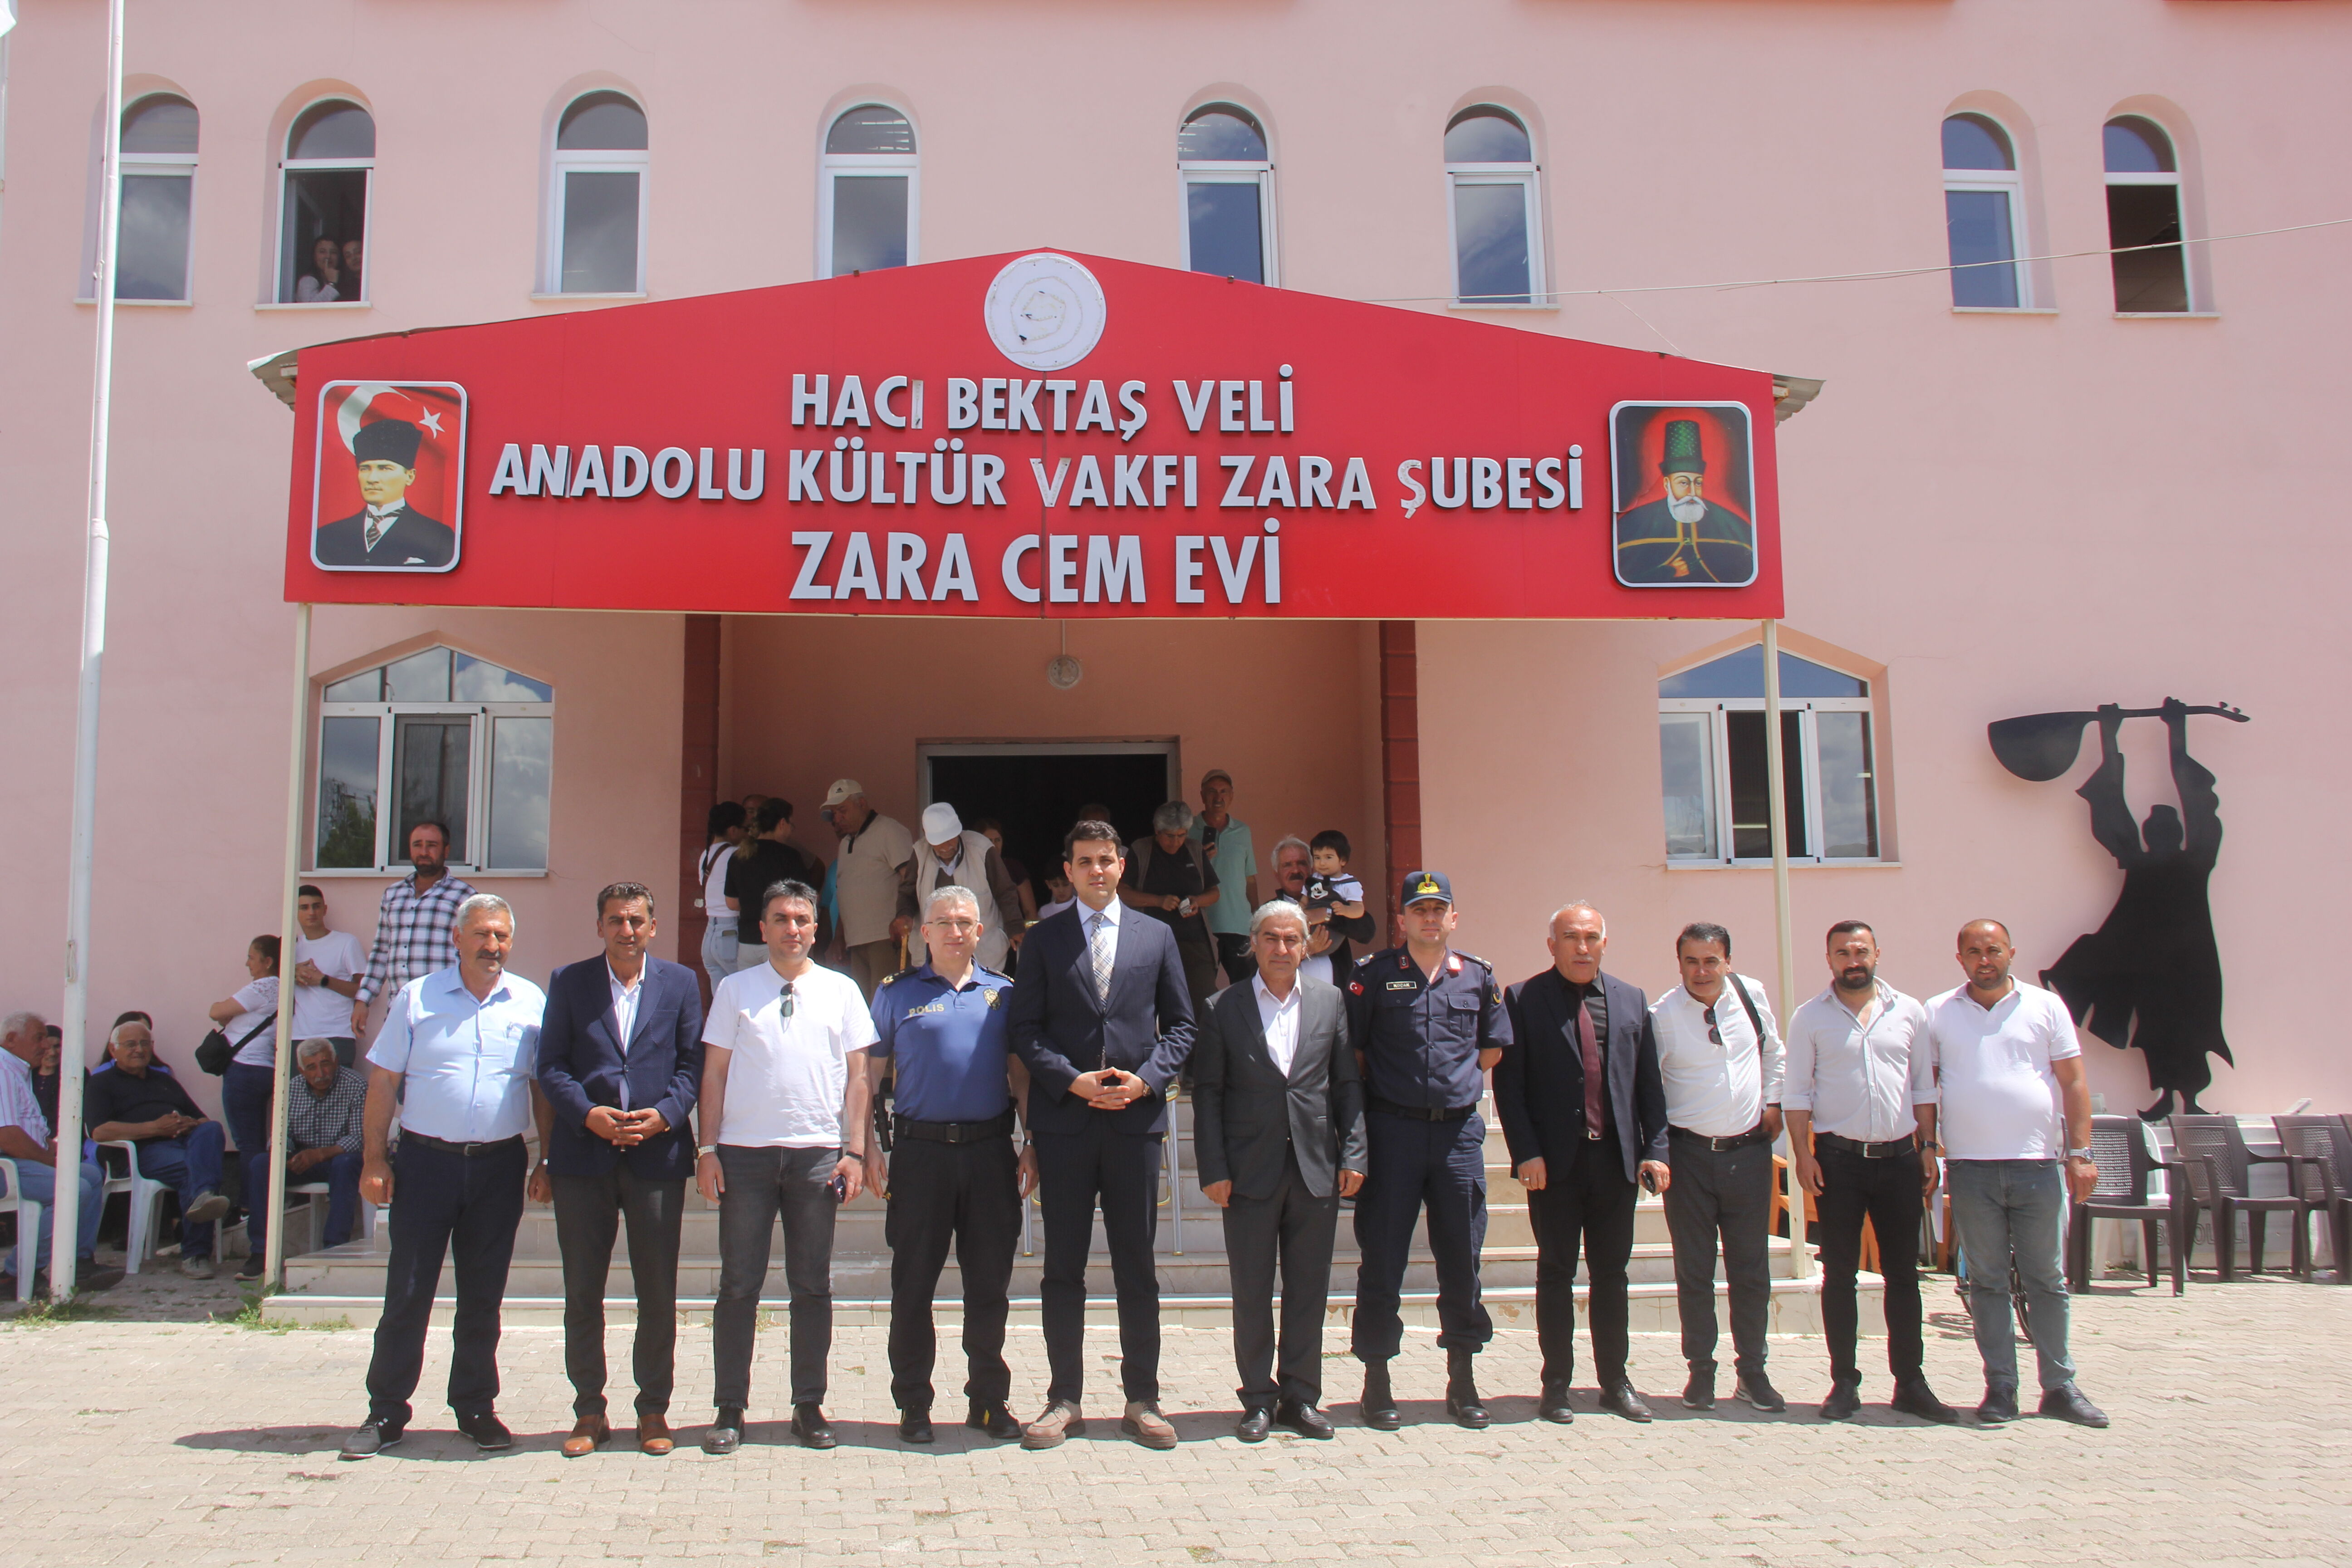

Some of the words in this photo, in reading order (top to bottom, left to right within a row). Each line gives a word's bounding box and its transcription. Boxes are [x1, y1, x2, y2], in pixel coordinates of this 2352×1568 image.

[792, 374, 925, 429] HACI
[948, 378, 1147, 442] BEKTAŞ
[1173, 364, 1294, 431] VELİ
[489, 444, 765, 500] ANADOLU
[789, 436, 1007, 505] KÜLTÜR
[1029, 455, 1197, 507] VAKFI
[1220, 456, 1377, 509] ZARA
[1398, 444, 1583, 519] ŞUBESİ
[789, 532, 979, 601] ZARA
[1002, 534, 1147, 603] CEM
[1176, 518, 1280, 603] EVİ
